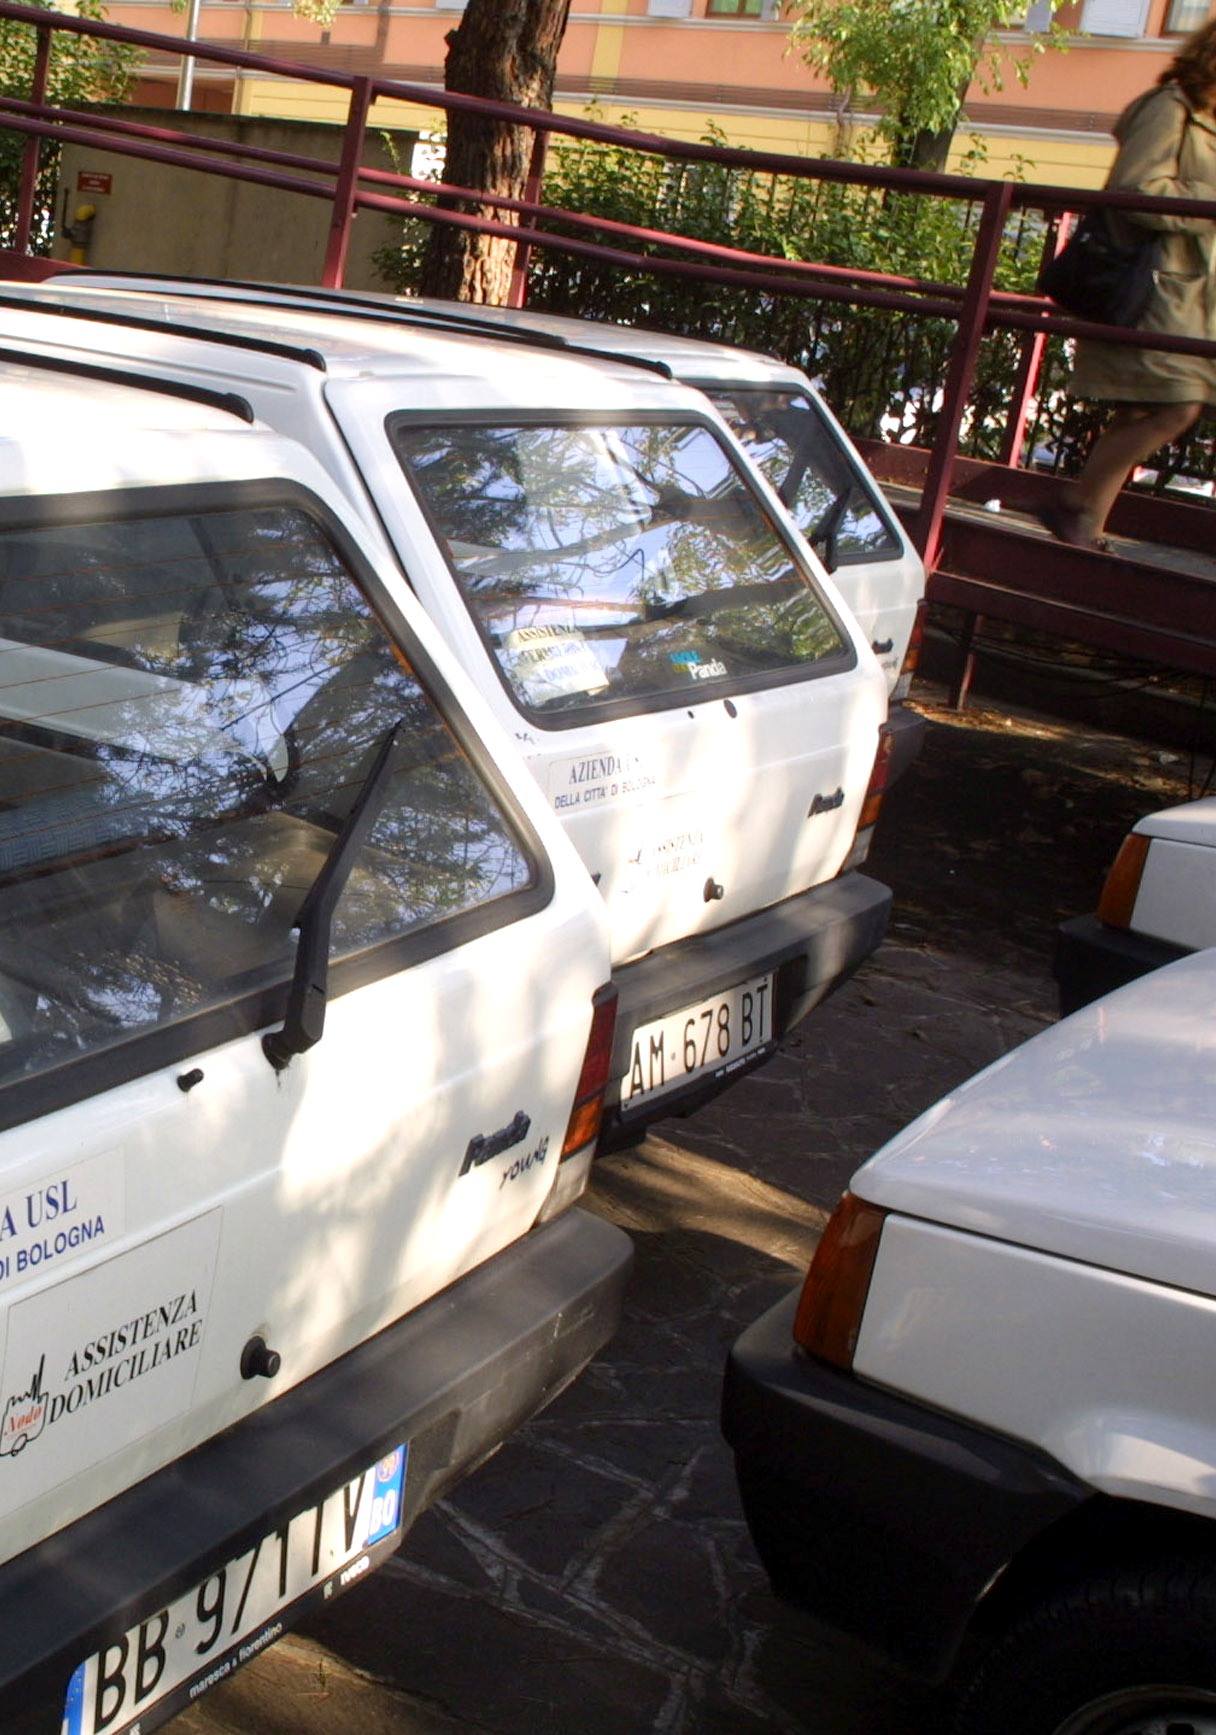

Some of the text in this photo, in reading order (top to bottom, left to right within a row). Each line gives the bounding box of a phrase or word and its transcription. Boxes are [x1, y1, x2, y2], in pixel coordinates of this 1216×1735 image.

[687, 658, 728, 680] Panda
[568, 755, 622, 785] AZIENDA
[554, 791, 581, 809] DELLA
[629, 1029, 665, 1100] AM
[683, 1002, 731, 1074] 678
[741, 983, 769, 1047] BT
[25, 1179, 78, 1228] USL
[16, 1215, 106, 1273] BOLOGNA
[63, 1289, 199, 1381] ASSISTENZA
[46, 1319, 203, 1425] DOMICILIARE
[3, 1405, 43, 1436] Nodo
[93, 1608, 170, 1734] BB
